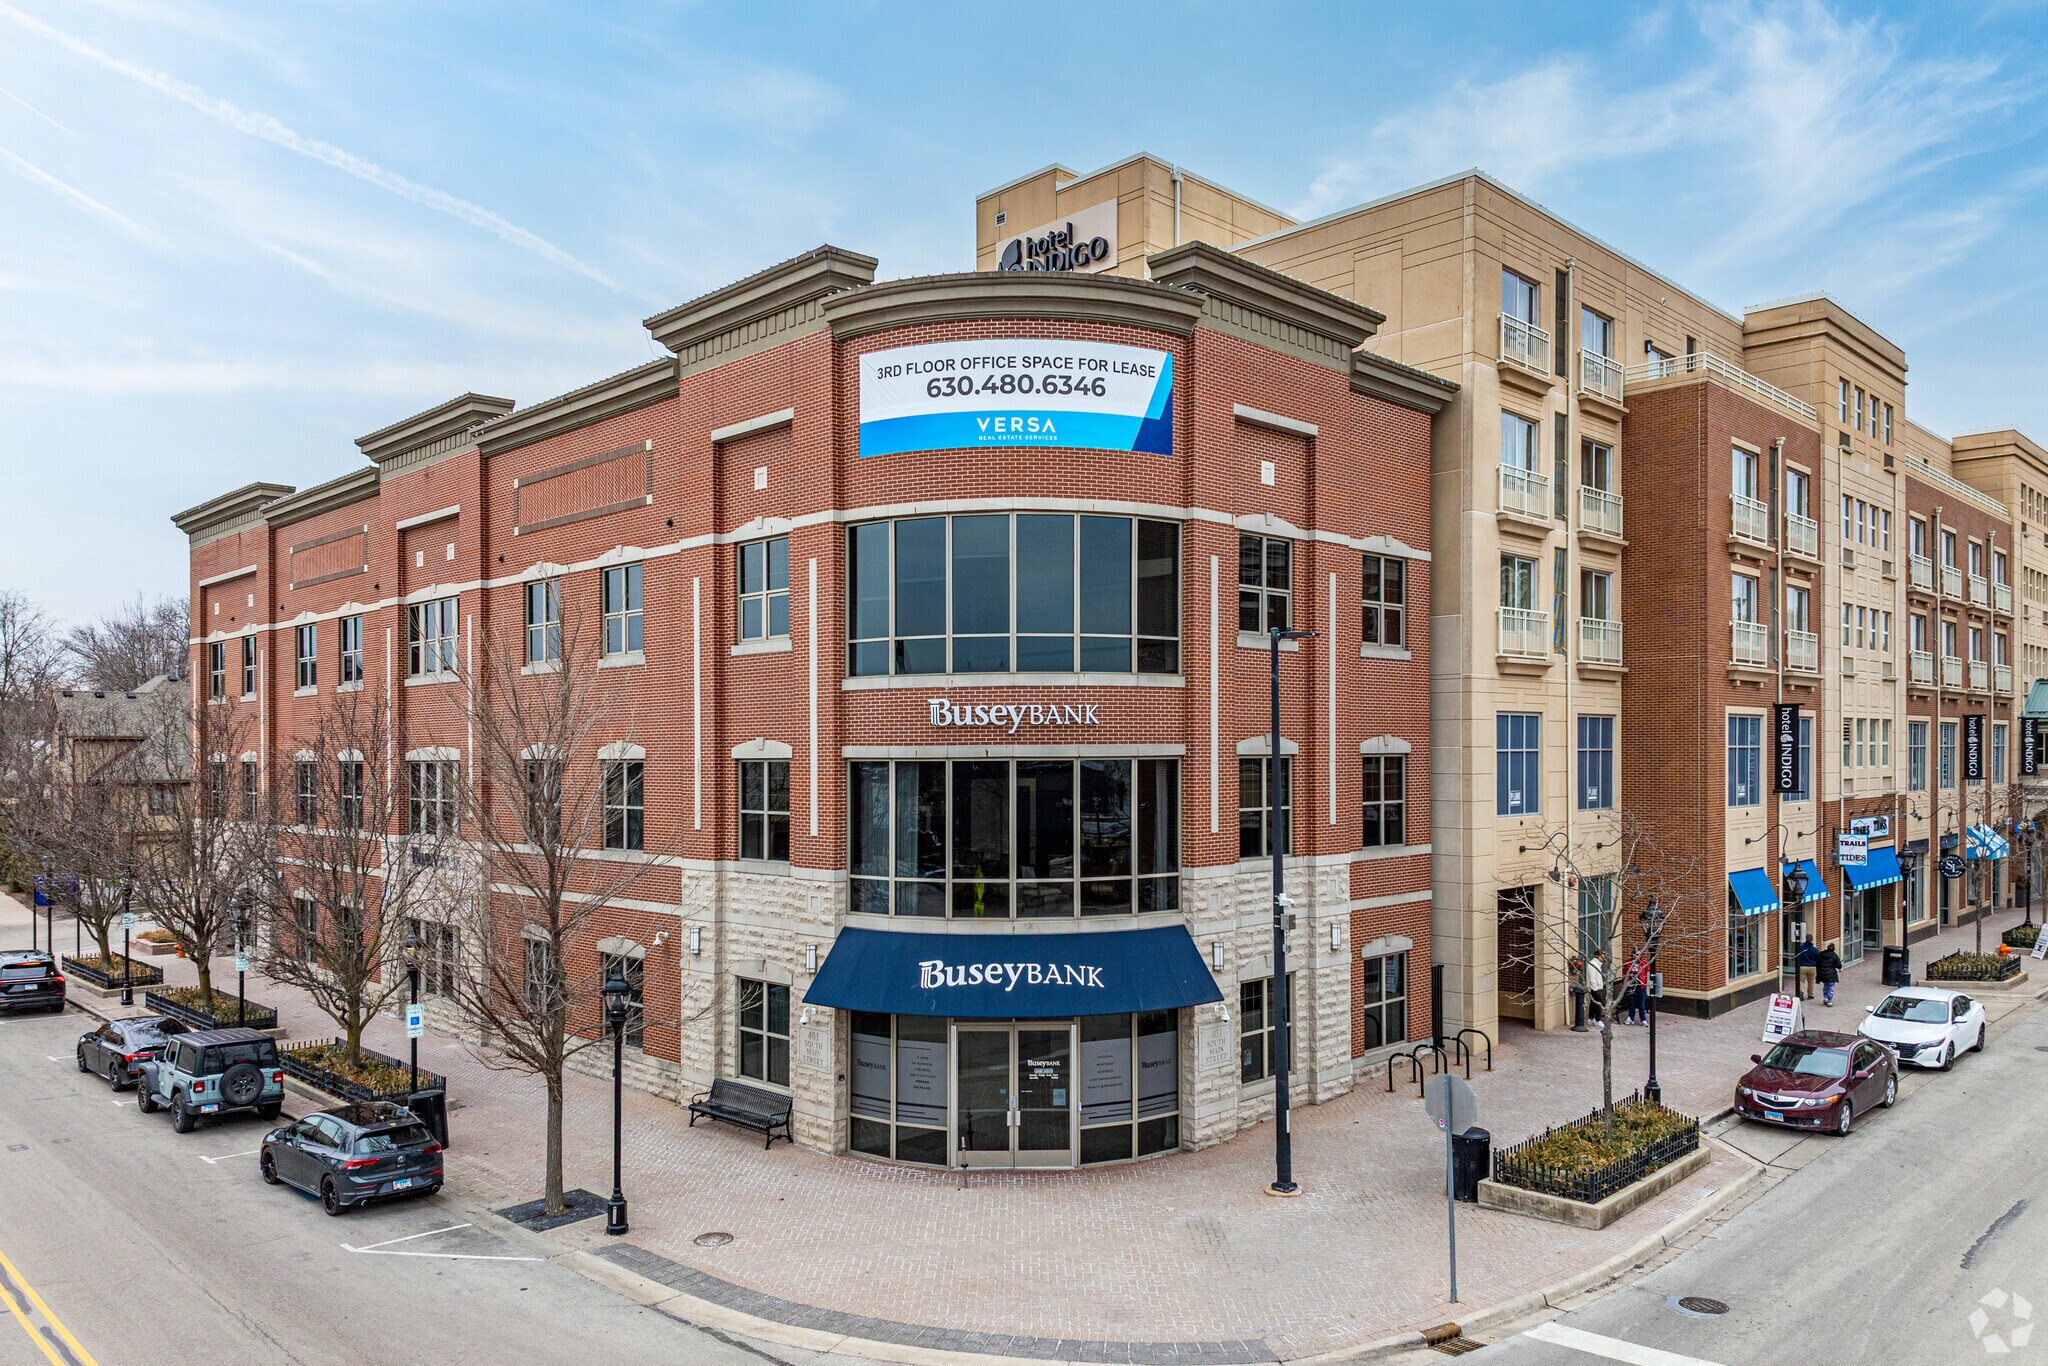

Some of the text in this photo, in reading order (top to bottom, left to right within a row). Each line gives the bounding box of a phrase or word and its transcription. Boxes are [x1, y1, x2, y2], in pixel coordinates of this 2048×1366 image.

[1026, 222, 1073, 259] hotel
[877, 356, 1156, 380] 3RD FLOOR OFFICE SPACE FOR LEASE
[926, 374, 1107, 398] 630.480.6346
[976, 416, 1056, 433] VERSA
[1781, 707, 1792, 788] hotel INDIGO
[1968, 717, 1978, 776] hotel INDIGO
[2025, 720, 2033, 773] hotel INDIGO
[1840, 854, 1866, 862] TIDES
[808, 1031, 819, 1041] 401
[804, 1040, 823, 1050] SOUTH
[1206, 1038, 1225, 1048] SOUTH
[806, 1048, 821, 1057] MAIN
[1209, 1047, 1223, 1055] MAIN
[802, 1055, 823, 1065] STREET
[1205, 1053, 1227, 1064] STREET
